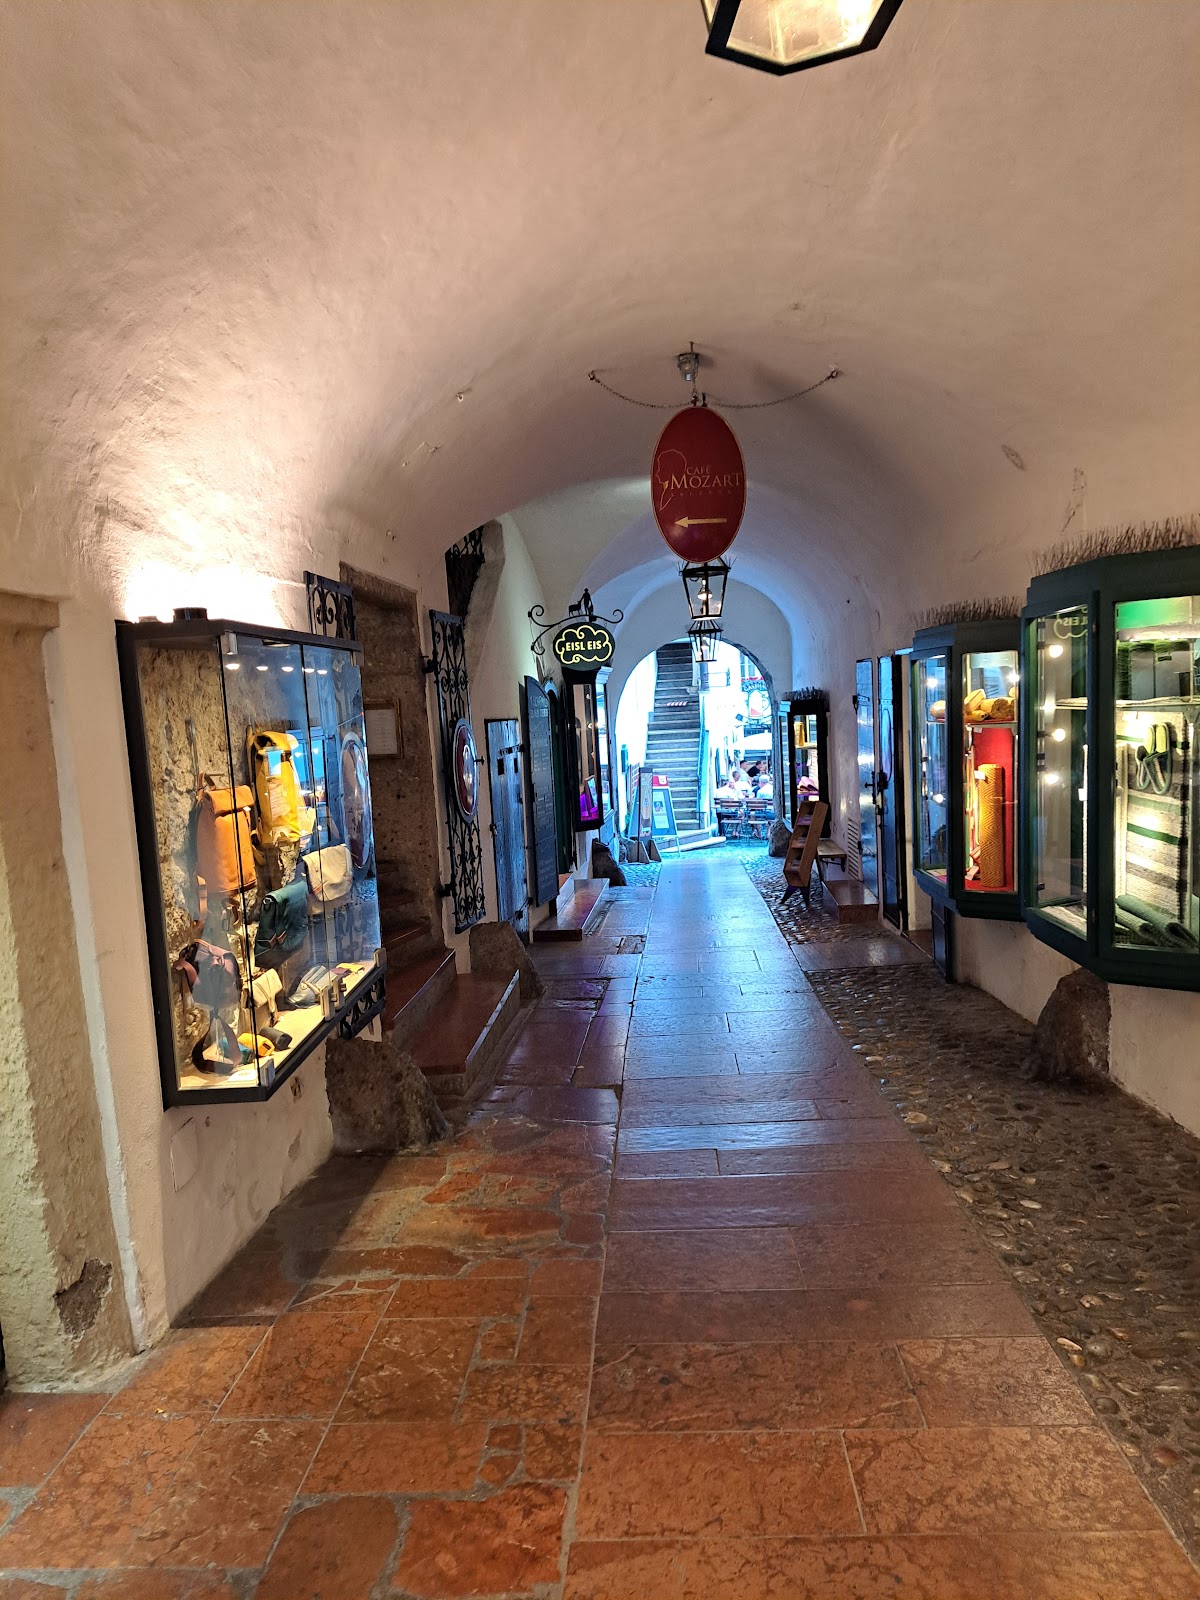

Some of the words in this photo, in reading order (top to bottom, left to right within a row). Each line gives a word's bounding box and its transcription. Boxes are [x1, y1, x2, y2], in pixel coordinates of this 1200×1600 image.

[670, 473, 742, 490] MOZART
[565, 641, 586, 652] EISL
[587, 640, 602, 650] EIS
